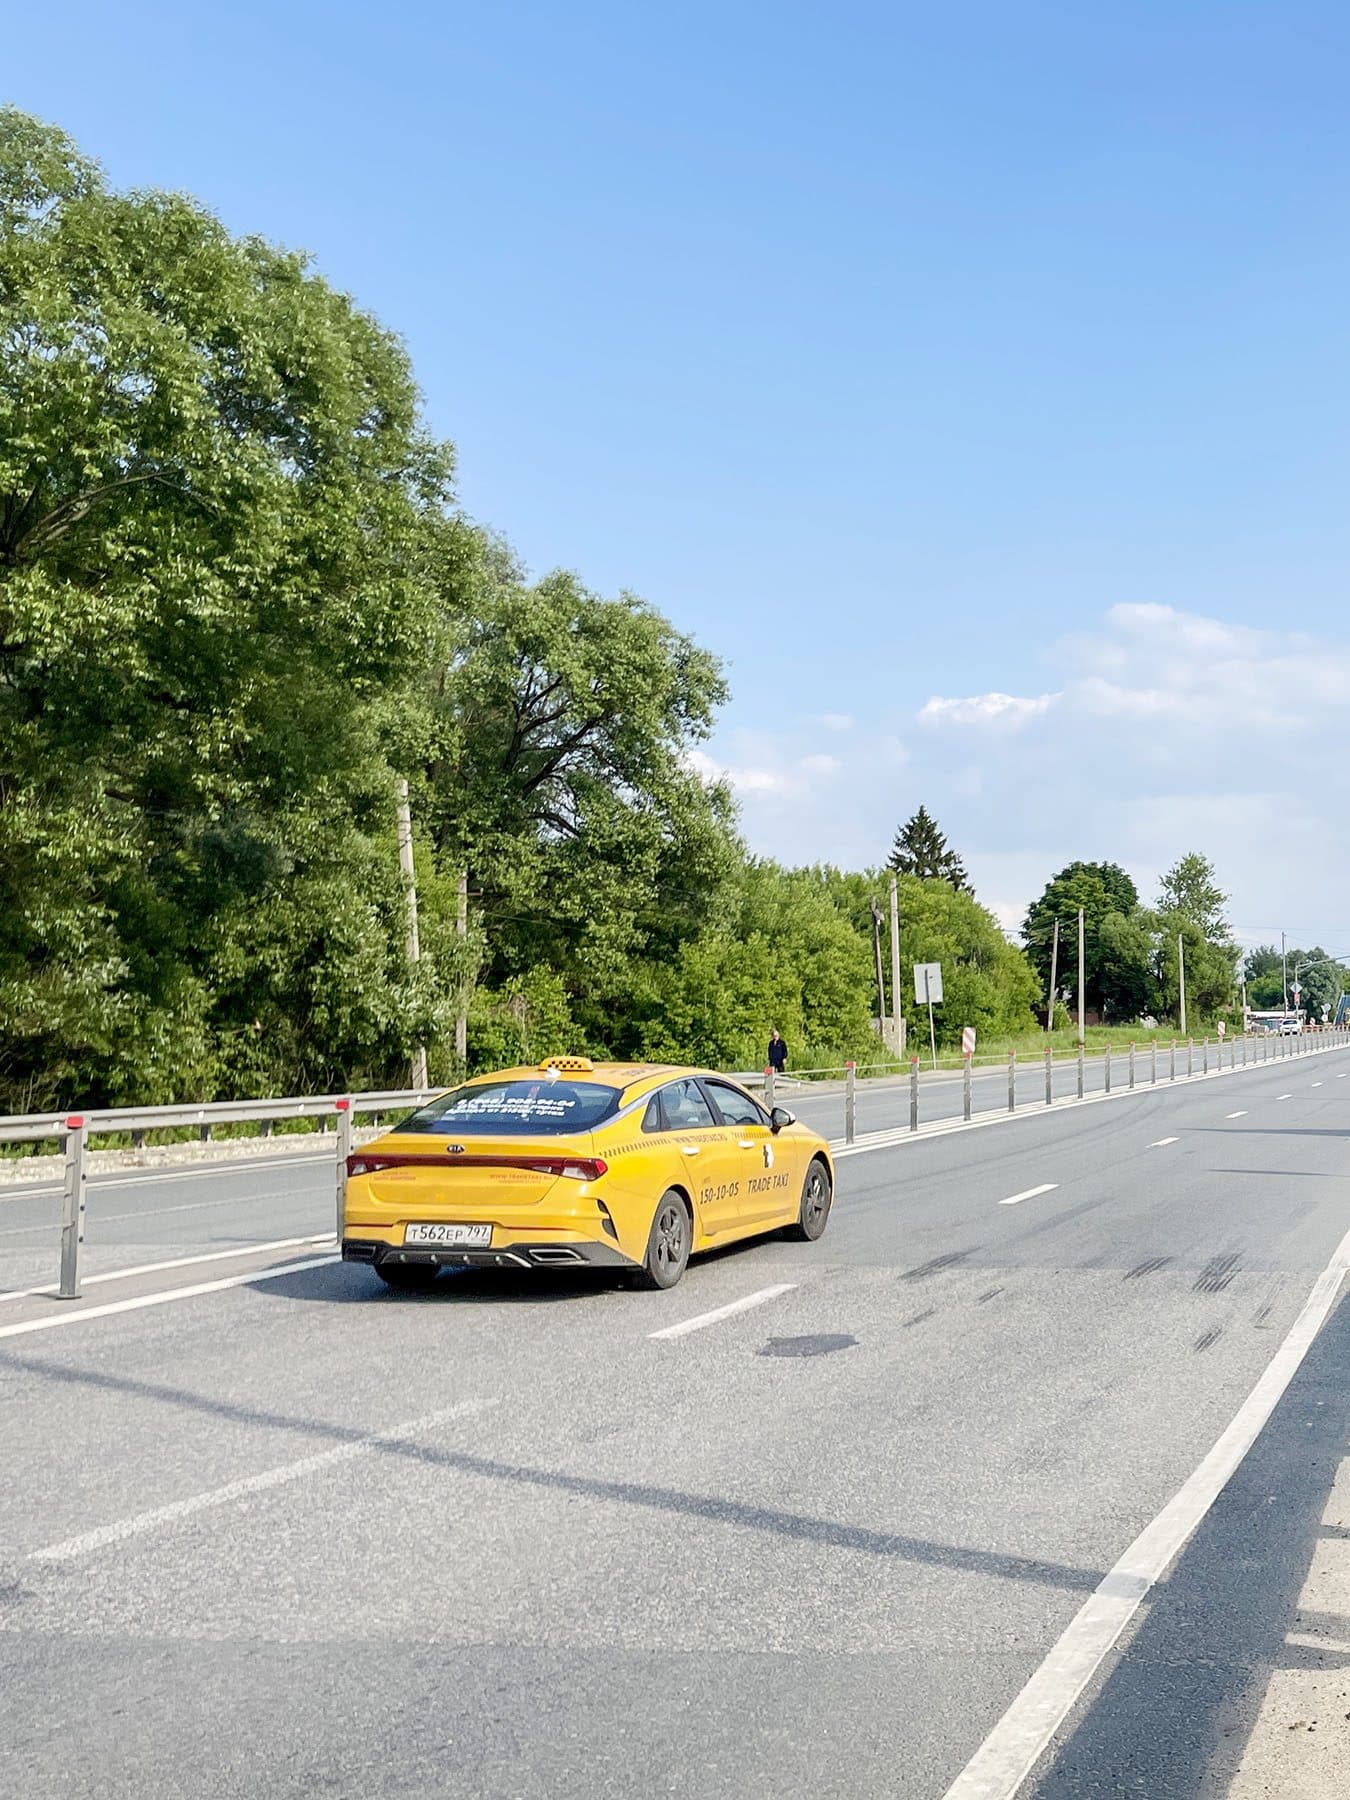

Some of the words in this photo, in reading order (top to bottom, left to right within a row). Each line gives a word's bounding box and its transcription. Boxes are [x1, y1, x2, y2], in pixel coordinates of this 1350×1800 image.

[448, 1144, 464, 1153] KIA
[700, 1181, 739, 1205] 150-10-05
[747, 1176, 771, 1194] TRADE
[773, 1173, 790, 1188] TAXI
[467, 1226, 488, 1238] 797
